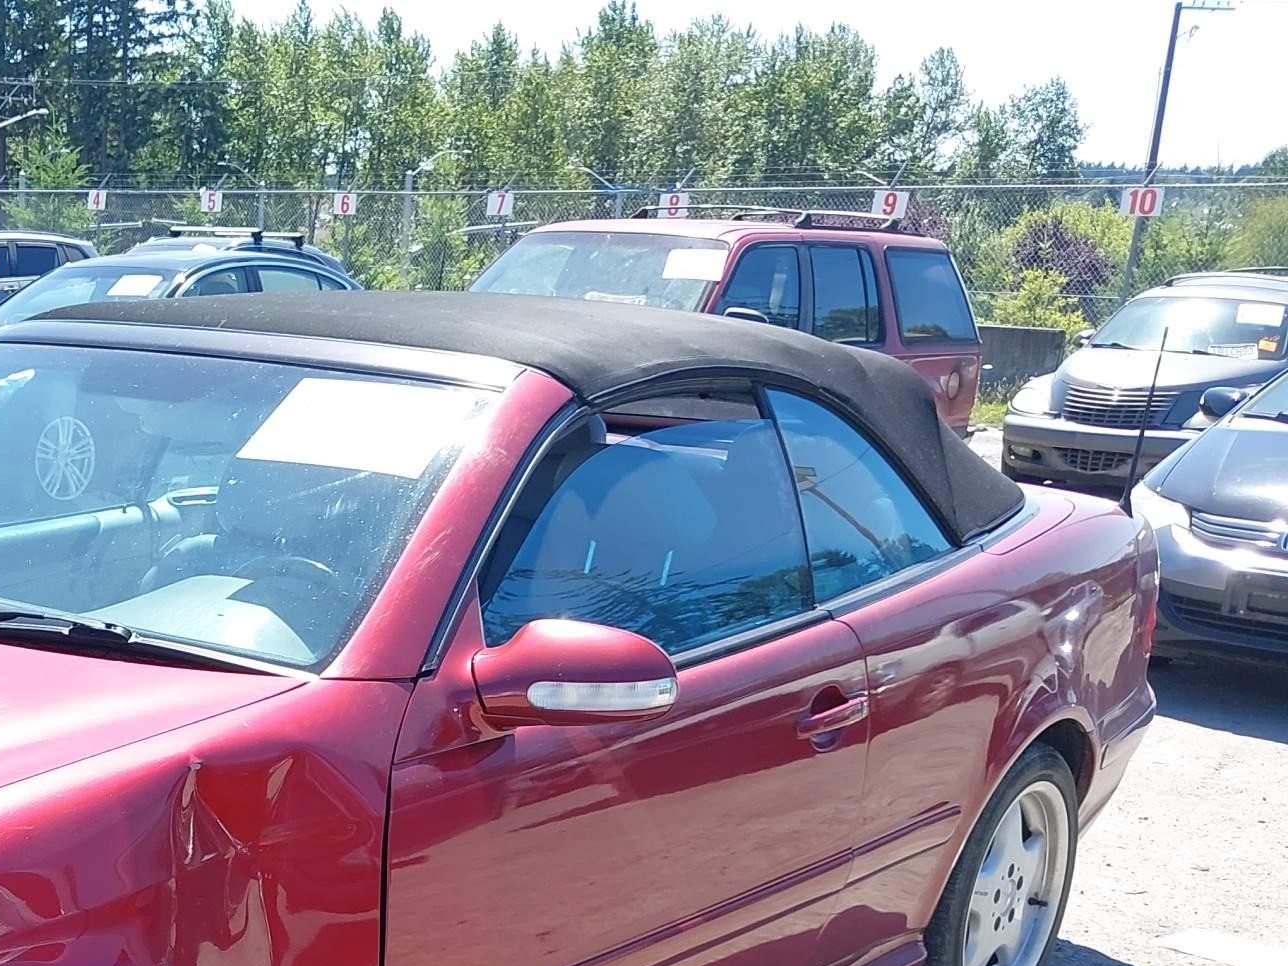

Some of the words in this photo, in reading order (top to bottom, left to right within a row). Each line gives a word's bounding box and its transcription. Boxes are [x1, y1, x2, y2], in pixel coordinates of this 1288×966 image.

[93, 191, 100, 209] 4
[207, 192, 216, 212] 5
[341, 194, 350, 214] 6
[497, 192, 506, 215] 7
[668, 194, 680, 216] 8
[882, 192, 898, 216] 9
[1129, 189, 1157, 215] 10
